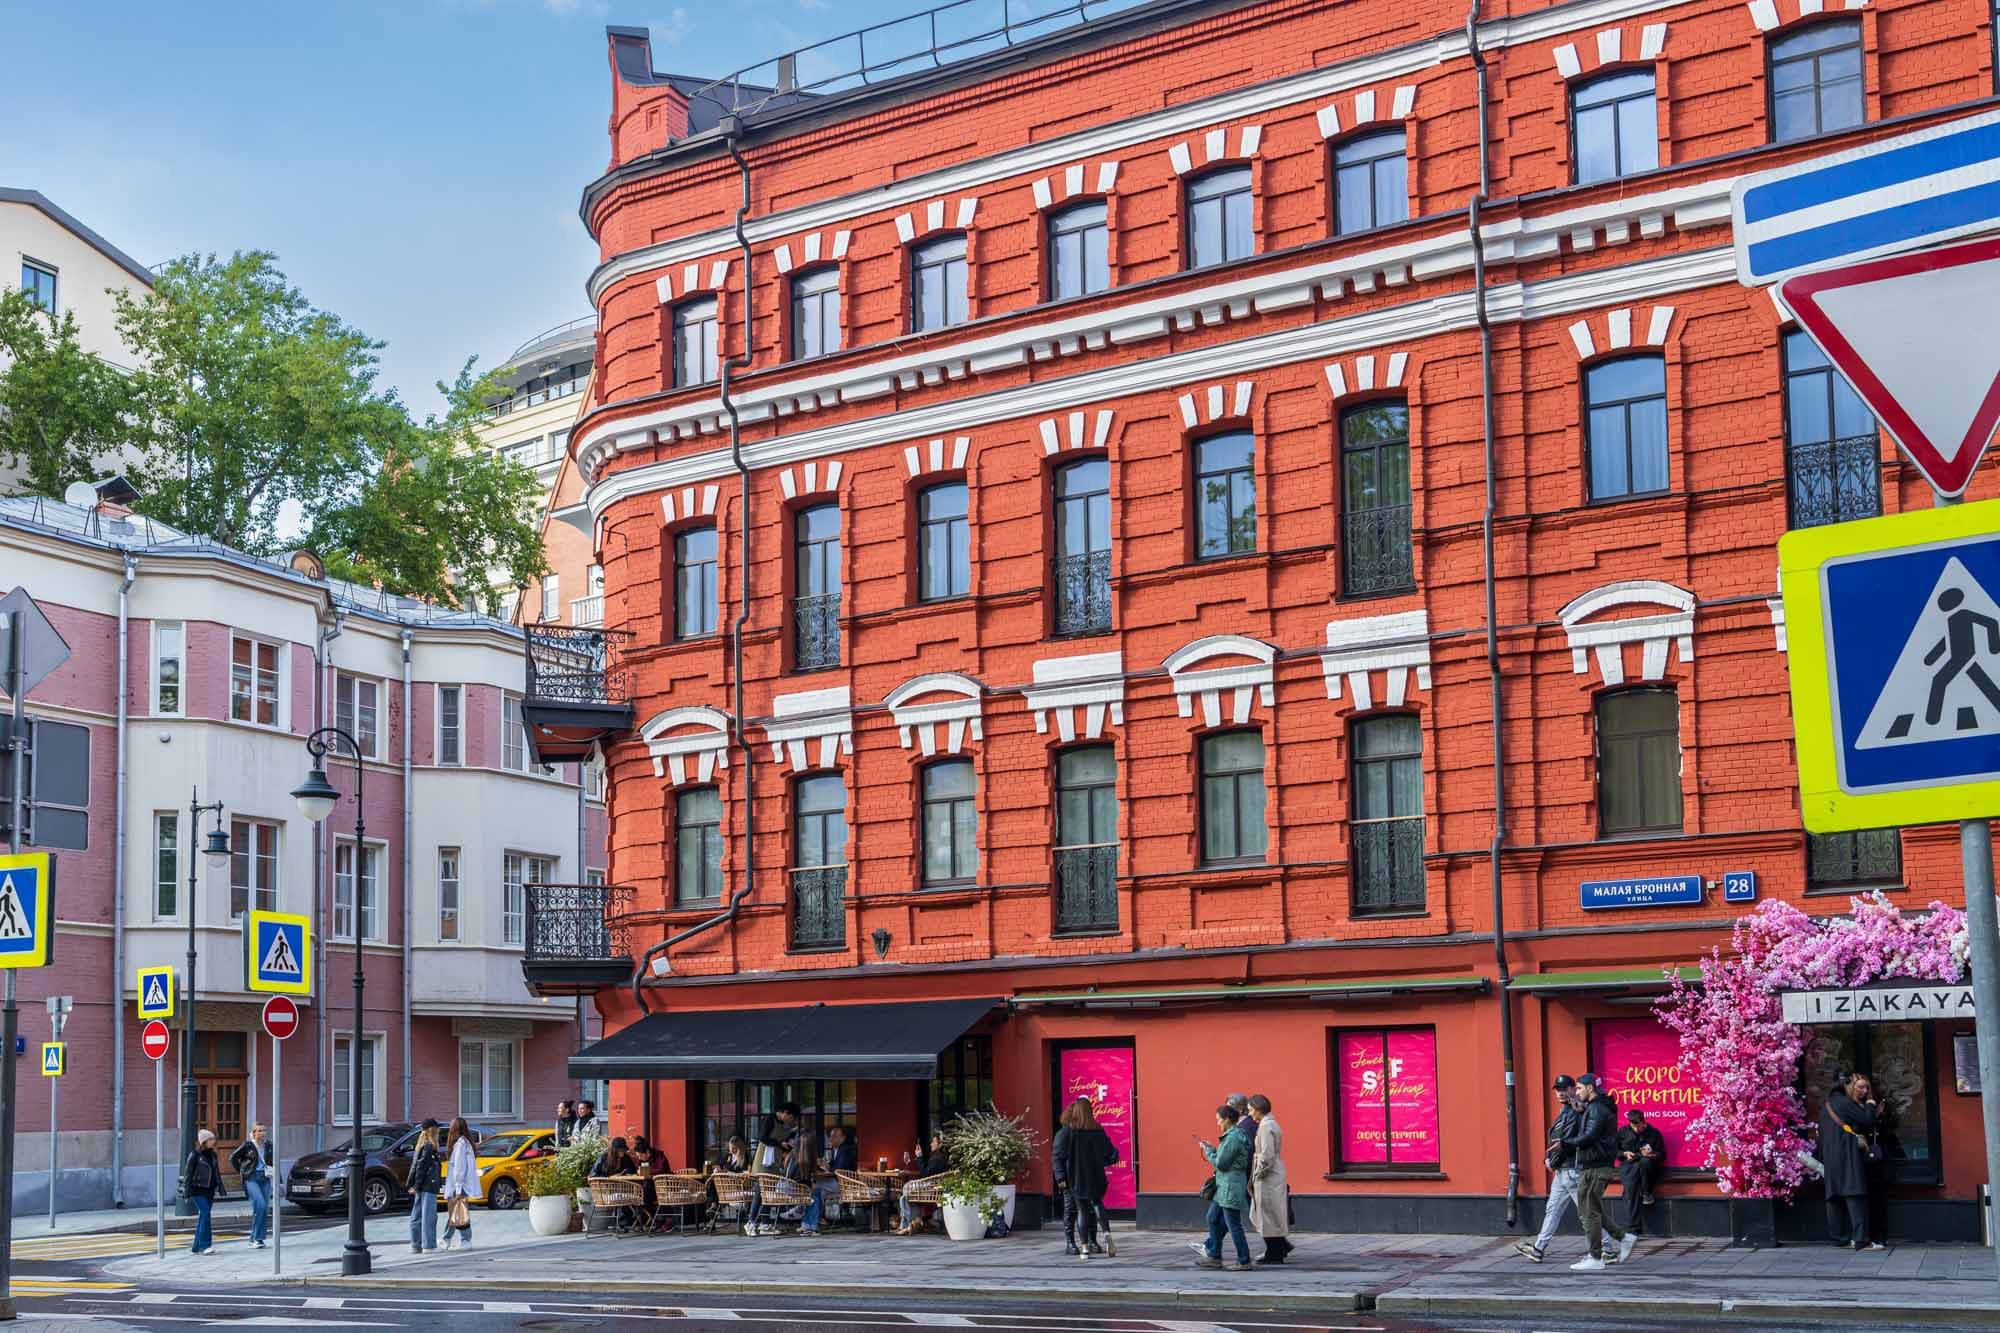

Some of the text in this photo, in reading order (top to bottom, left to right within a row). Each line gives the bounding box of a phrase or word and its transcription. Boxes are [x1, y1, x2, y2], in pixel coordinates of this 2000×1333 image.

[1593, 882, 1687, 897] МАЛАЯ БРОННАЯ
[1728, 878, 1749, 894] 28
[1815, 991, 1975, 1014] IZAKAYA
[1626, 1066, 1681, 1084] СКОРО
[1662, 1110, 1686, 1118] SOON
